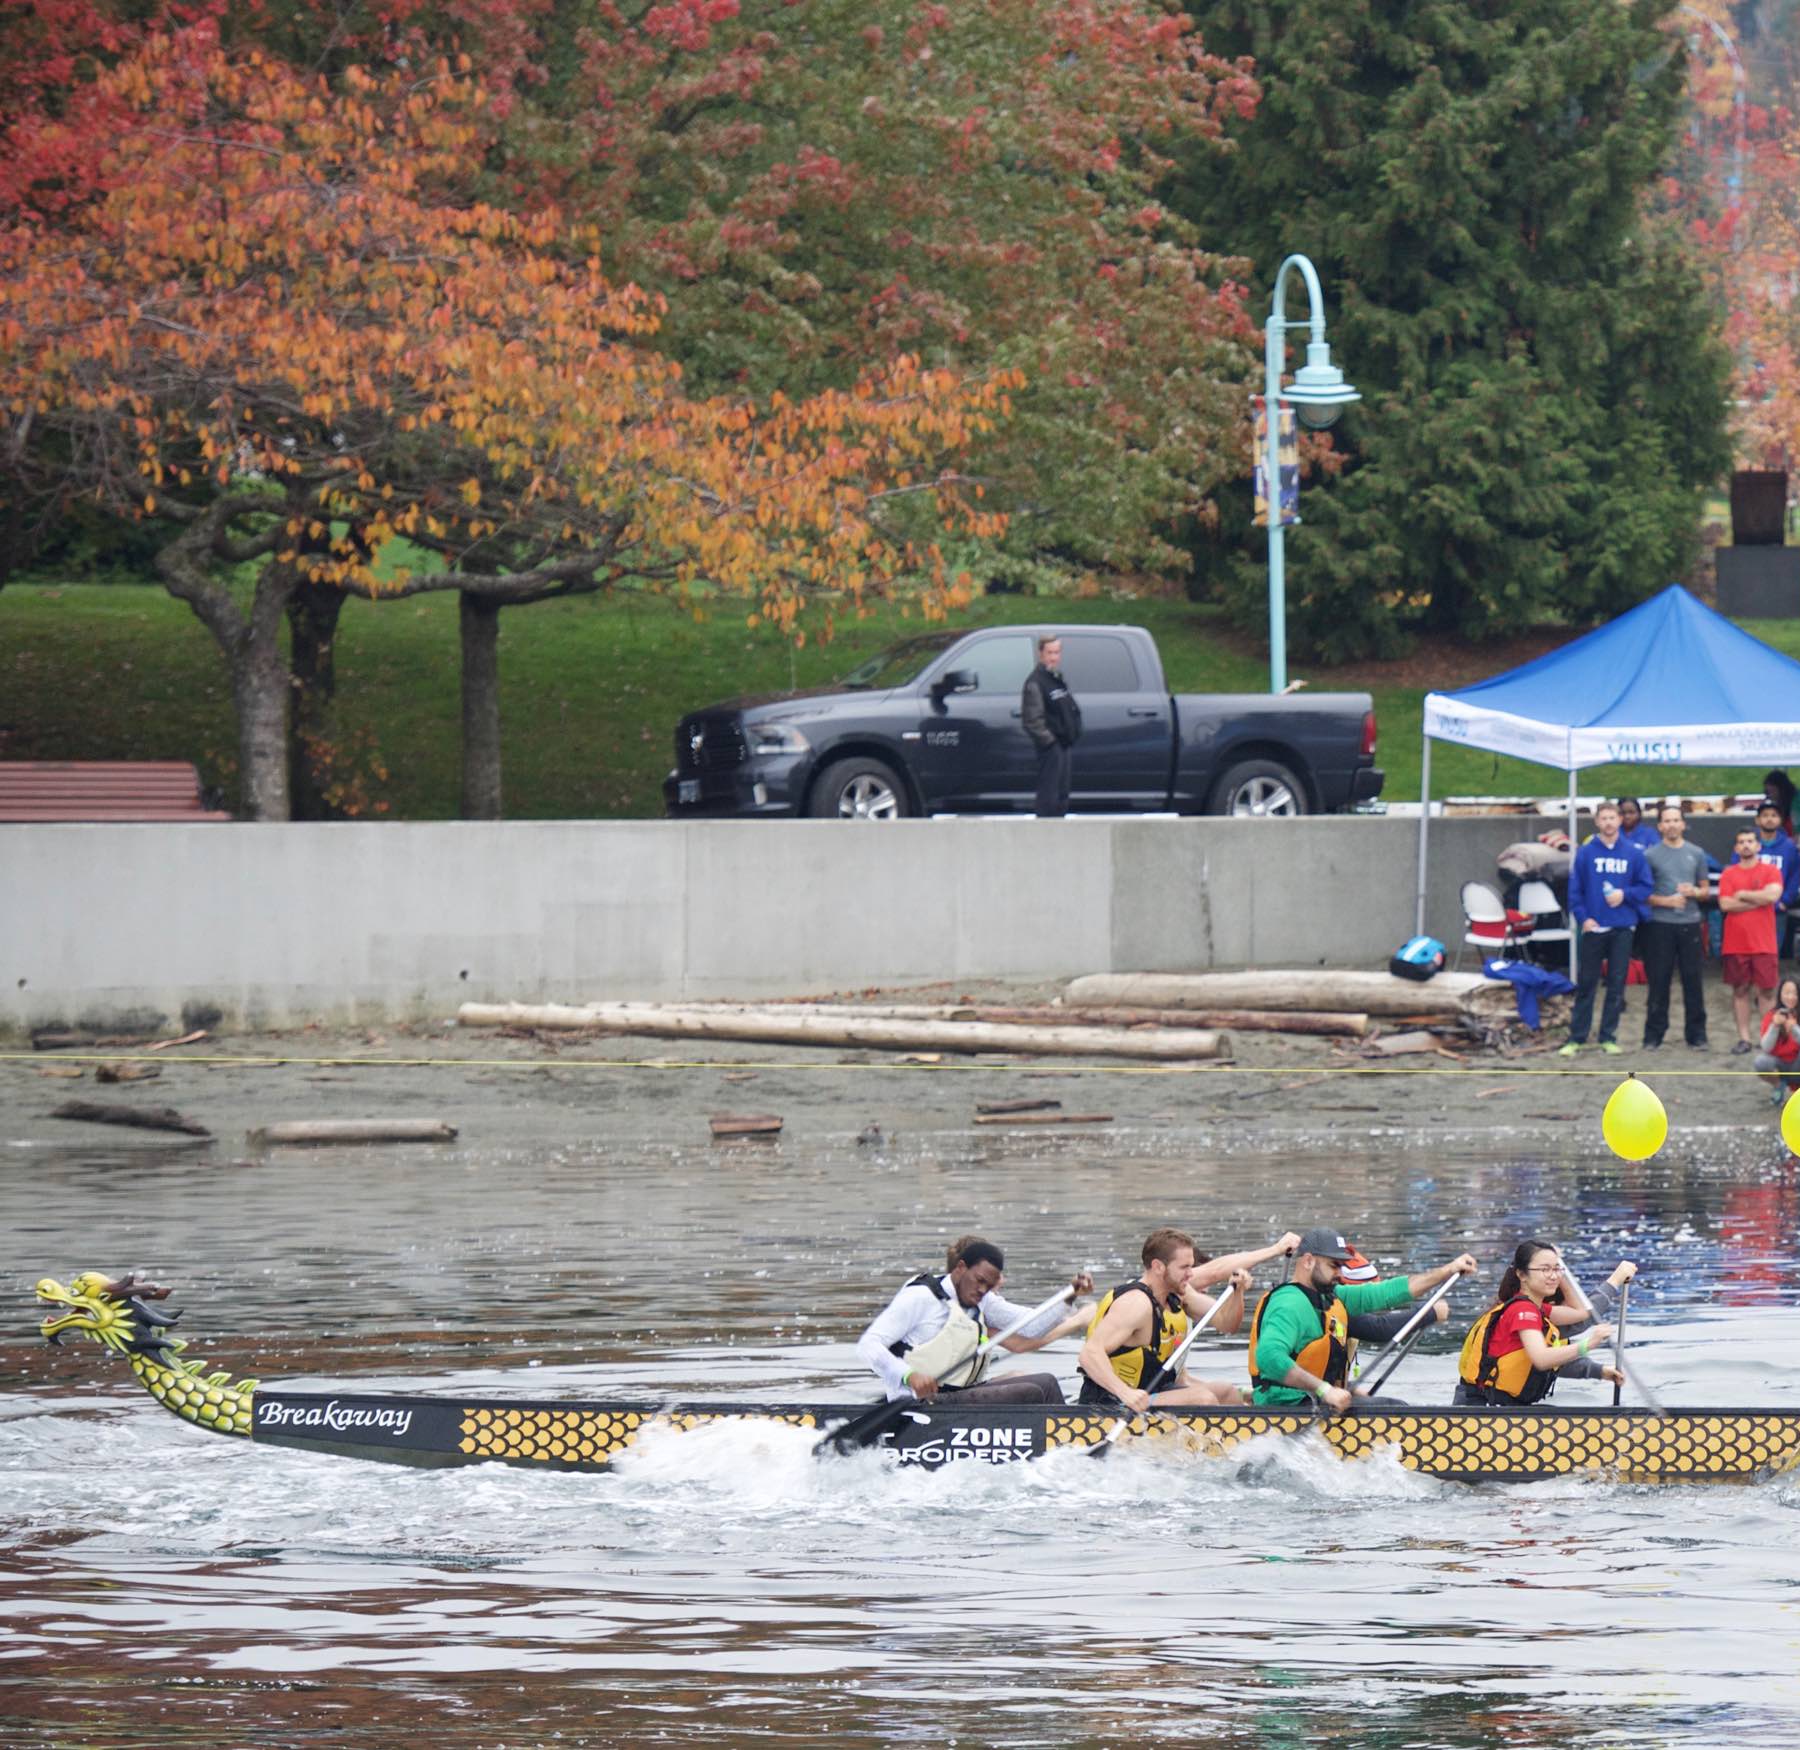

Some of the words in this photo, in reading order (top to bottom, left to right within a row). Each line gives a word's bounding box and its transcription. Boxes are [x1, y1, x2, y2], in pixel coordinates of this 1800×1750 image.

[1608, 741, 1682, 763] VIUSU
[1594, 857, 1628, 874] TRU
[258, 1400, 413, 1435] Breakaway
[951, 1428, 1022, 1446] ZONE
